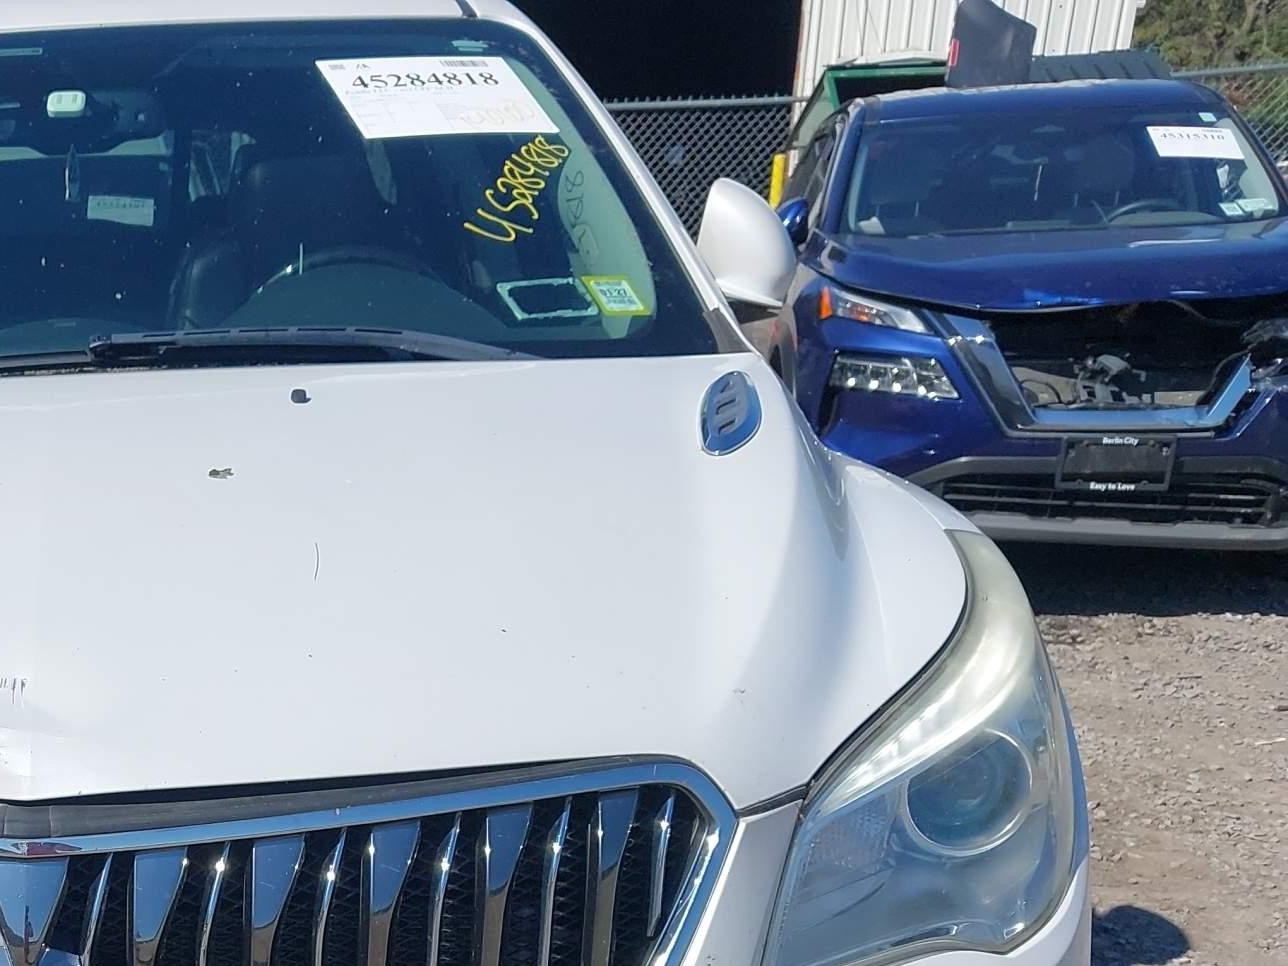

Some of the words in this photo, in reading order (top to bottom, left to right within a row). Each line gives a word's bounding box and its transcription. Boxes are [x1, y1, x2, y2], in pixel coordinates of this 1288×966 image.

[352, 72, 499, 89] 45284818
[1103, 437, 1123, 445] Berlin
[1124, 437, 1140, 446] City
[1089, 482, 1107, 491] Easy
